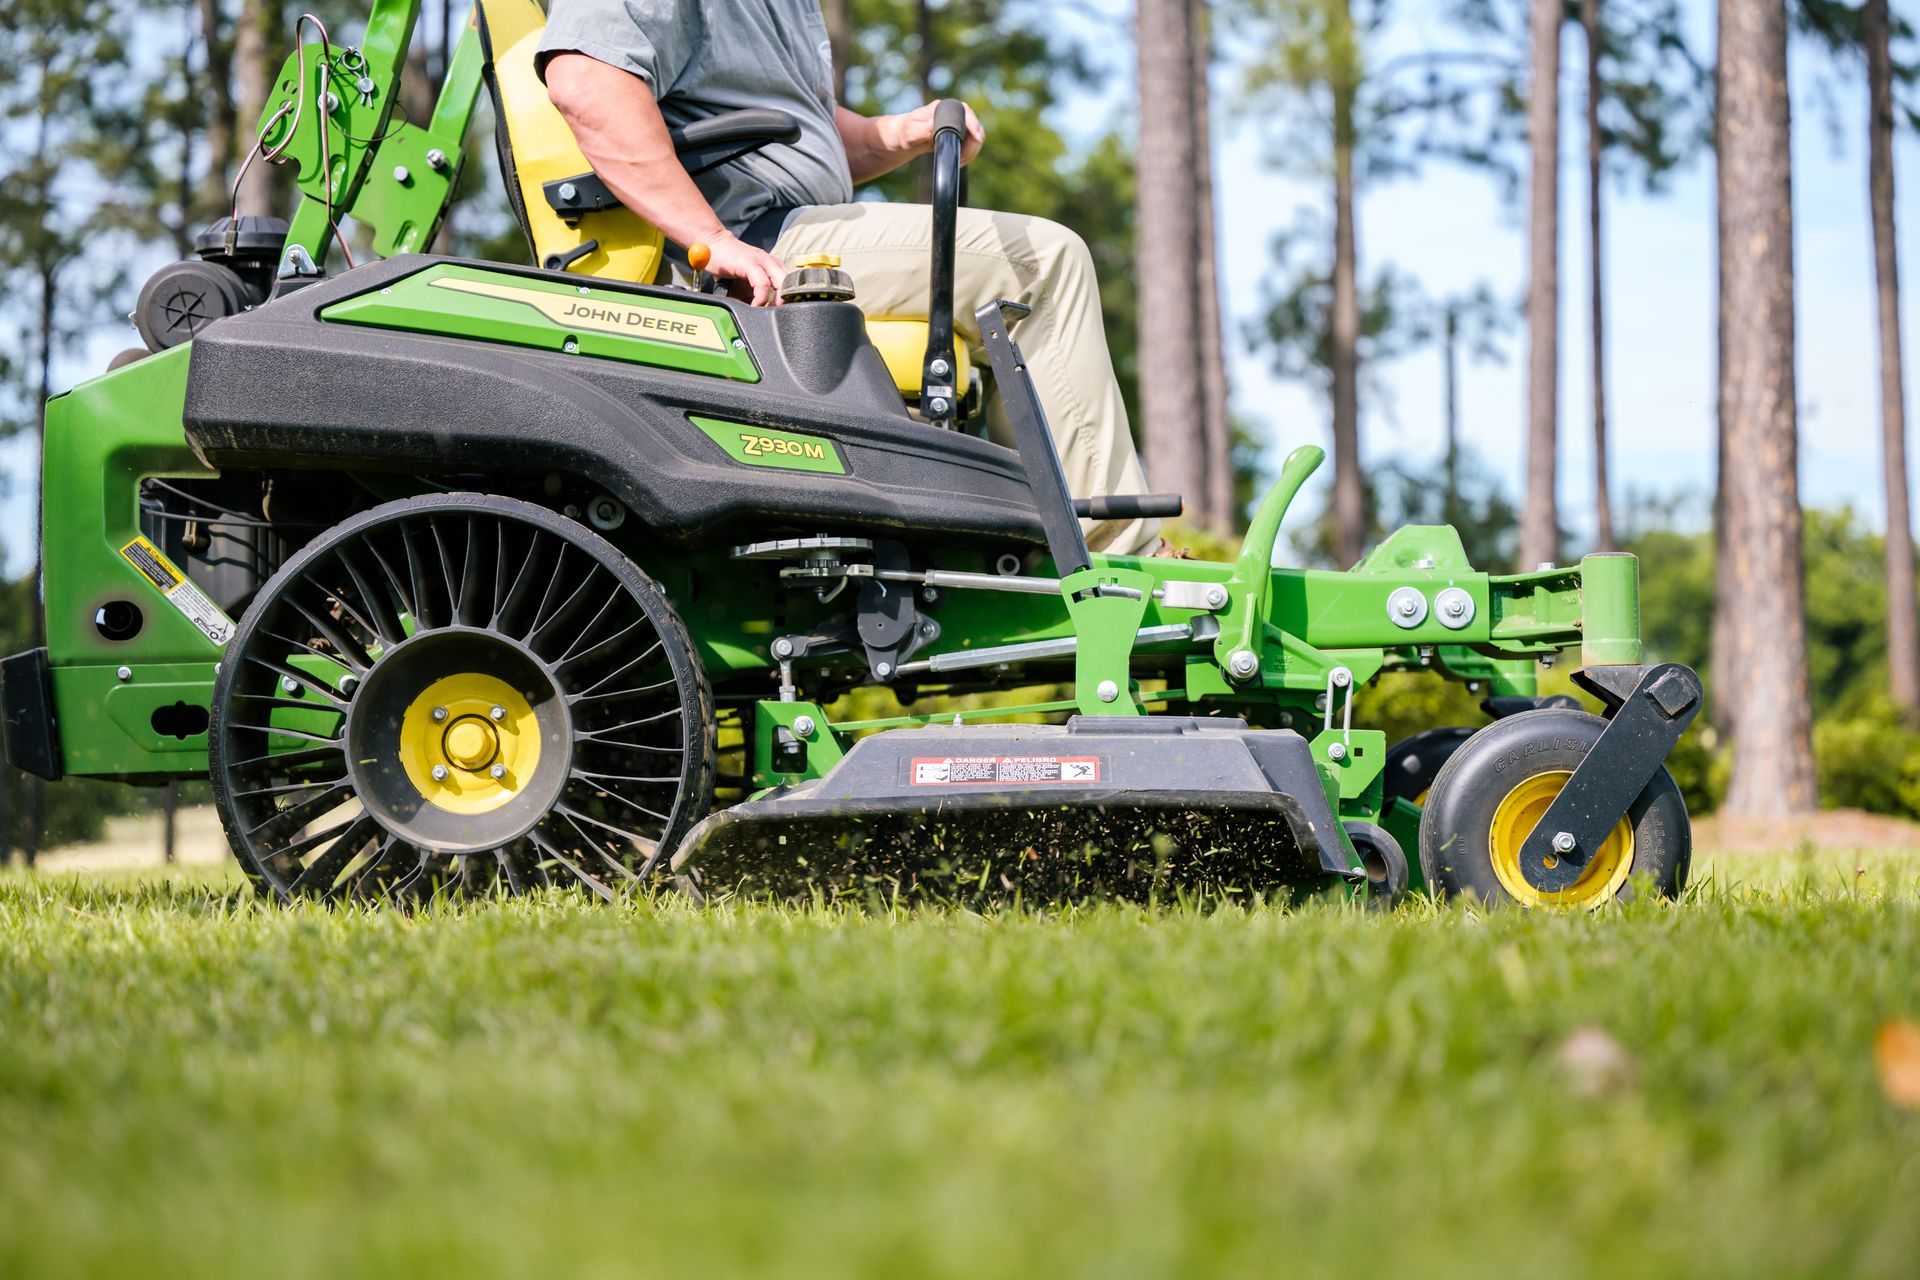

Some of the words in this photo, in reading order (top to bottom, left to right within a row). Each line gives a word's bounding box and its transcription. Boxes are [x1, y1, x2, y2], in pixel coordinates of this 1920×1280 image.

[564, 303, 621, 323] JOHN
[626, 312, 698, 336] DEERE
[740, 434, 825, 460] Z930M
[150, 550, 175, 575] CAUTION
[1494, 738, 1590, 773] CARLISL
